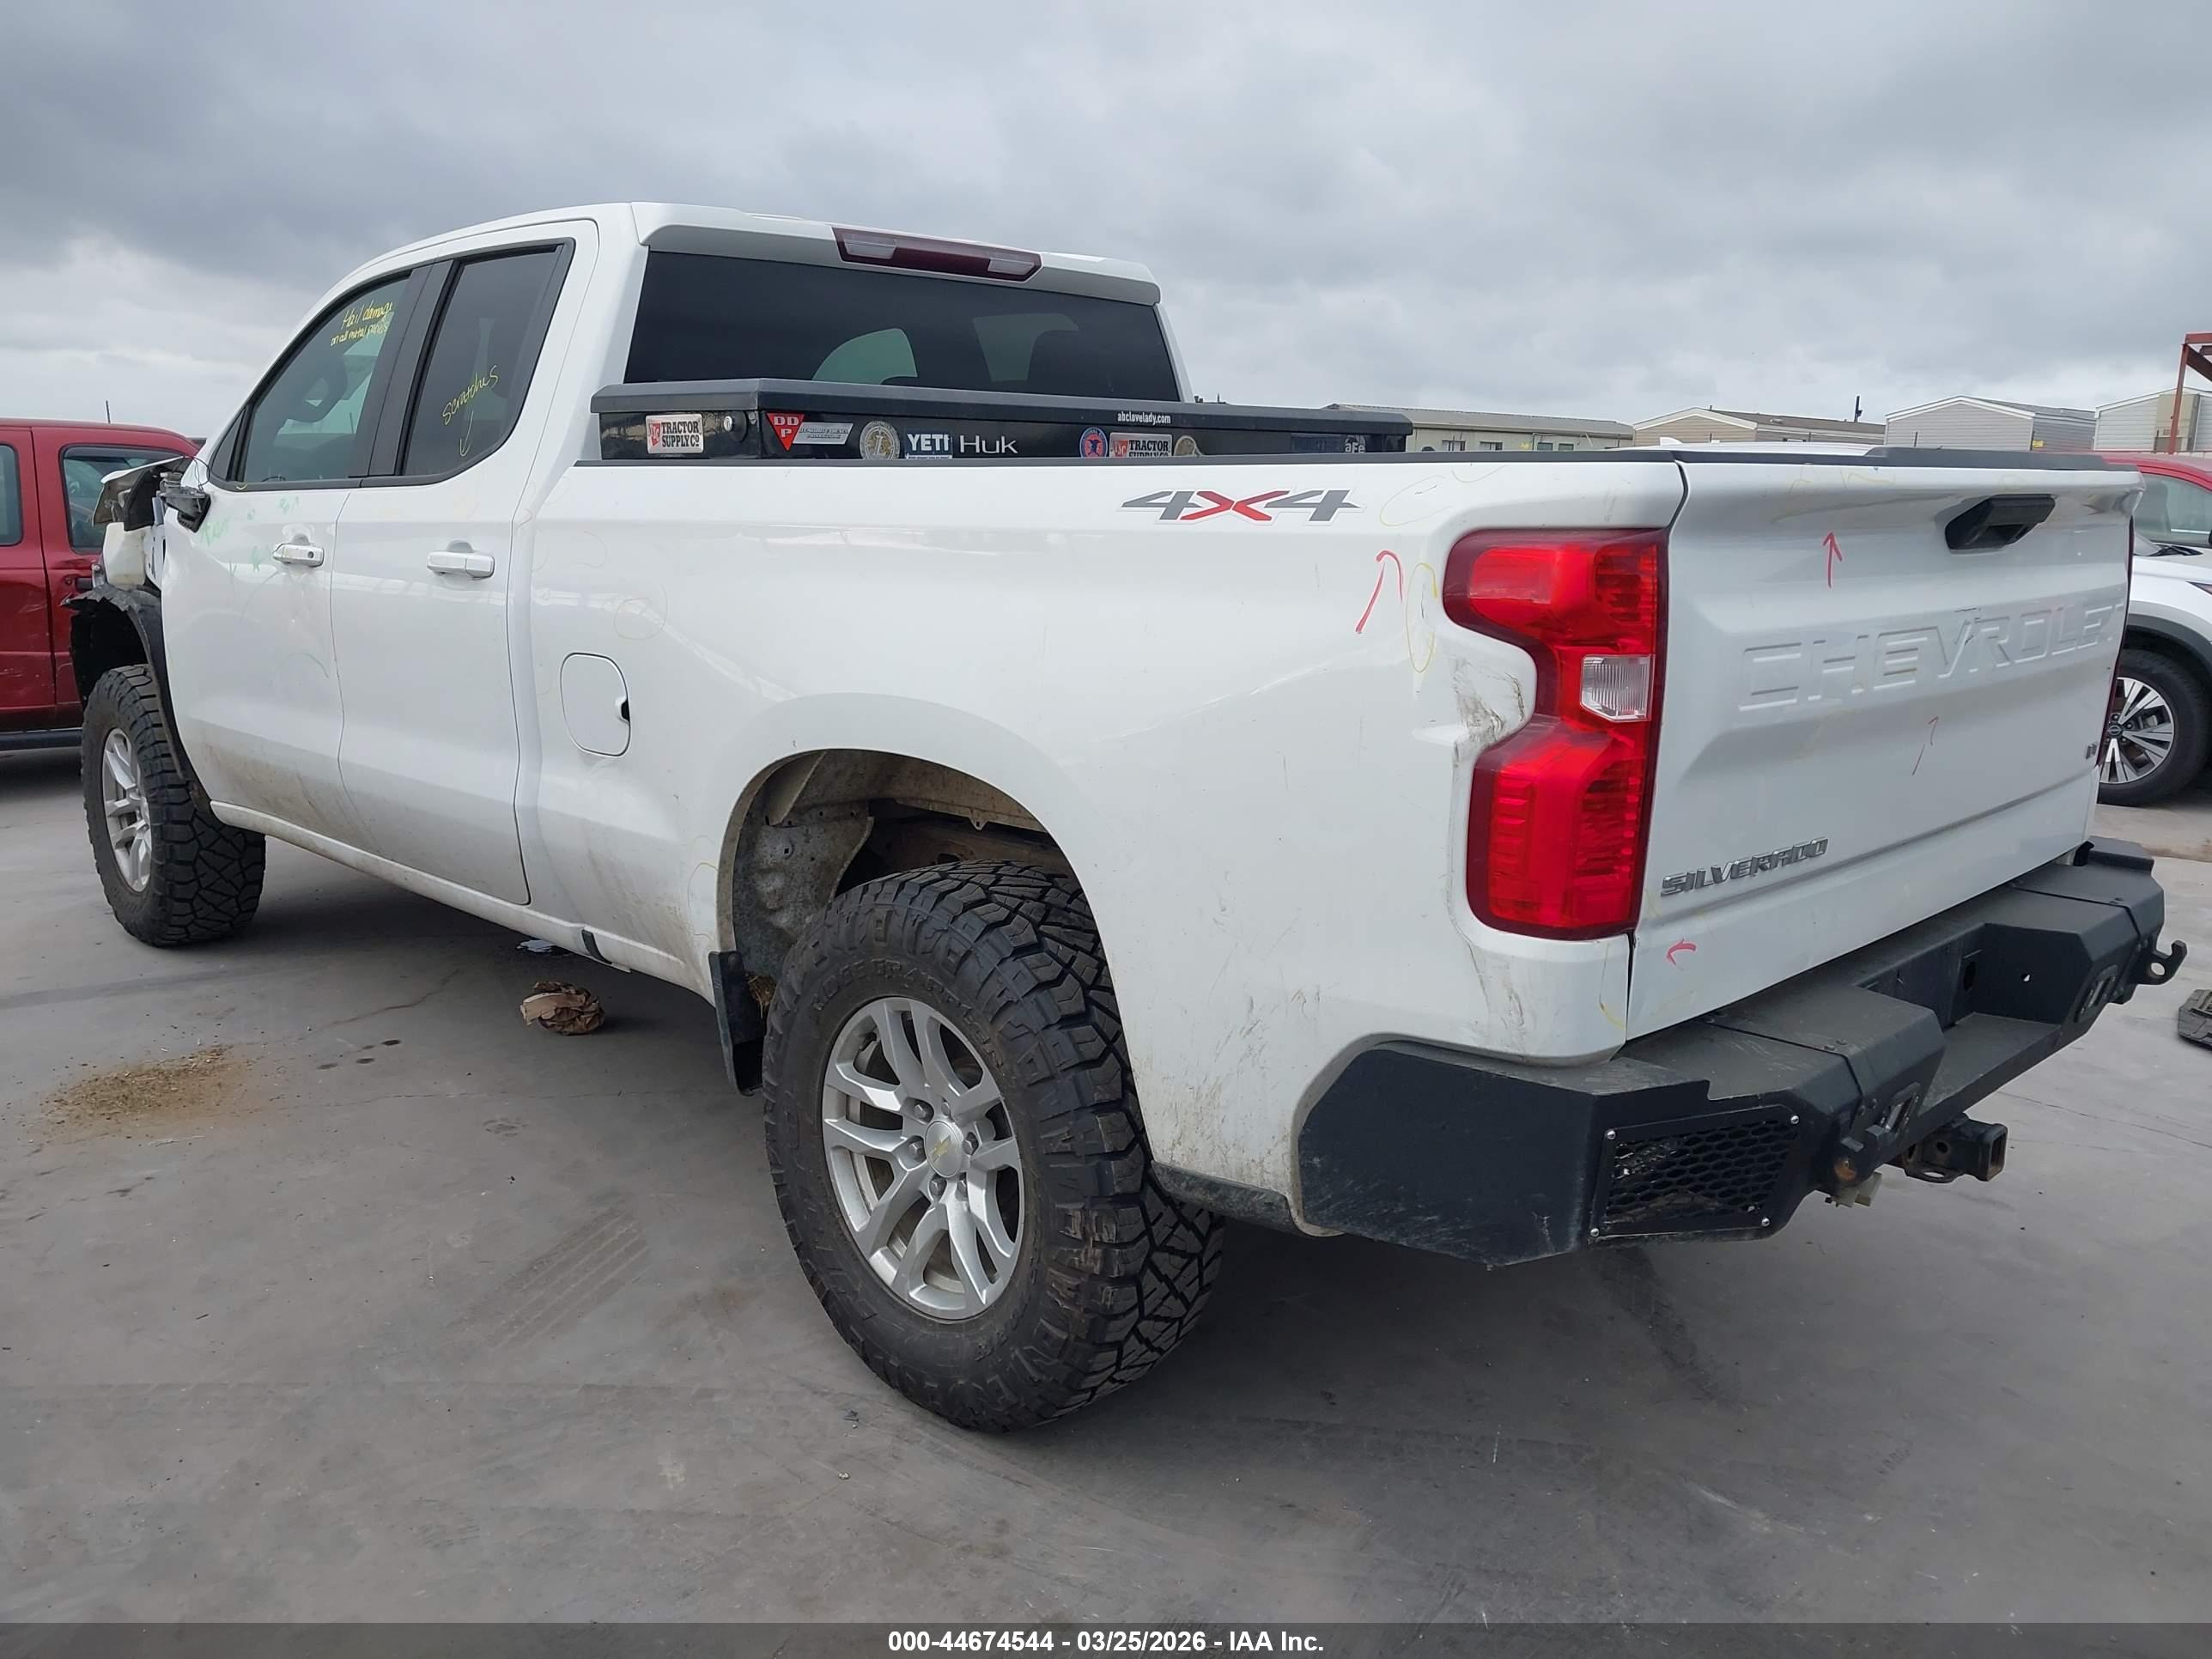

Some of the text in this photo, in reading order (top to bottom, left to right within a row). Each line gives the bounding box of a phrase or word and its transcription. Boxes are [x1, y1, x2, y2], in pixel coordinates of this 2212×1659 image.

[1117, 410, 1171, 426] abclovelady.com
[661, 421, 699, 434] TRACTOR
[661, 434, 690, 447] SUPPLY
[906, 433, 949, 452] YETI
[959, 434, 1018, 454] Huk
[1129, 439, 1168, 452] TRACTOR
[1345, 441, 1366, 453] aFe
[1660, 836, 1829, 897] SILVERADO
